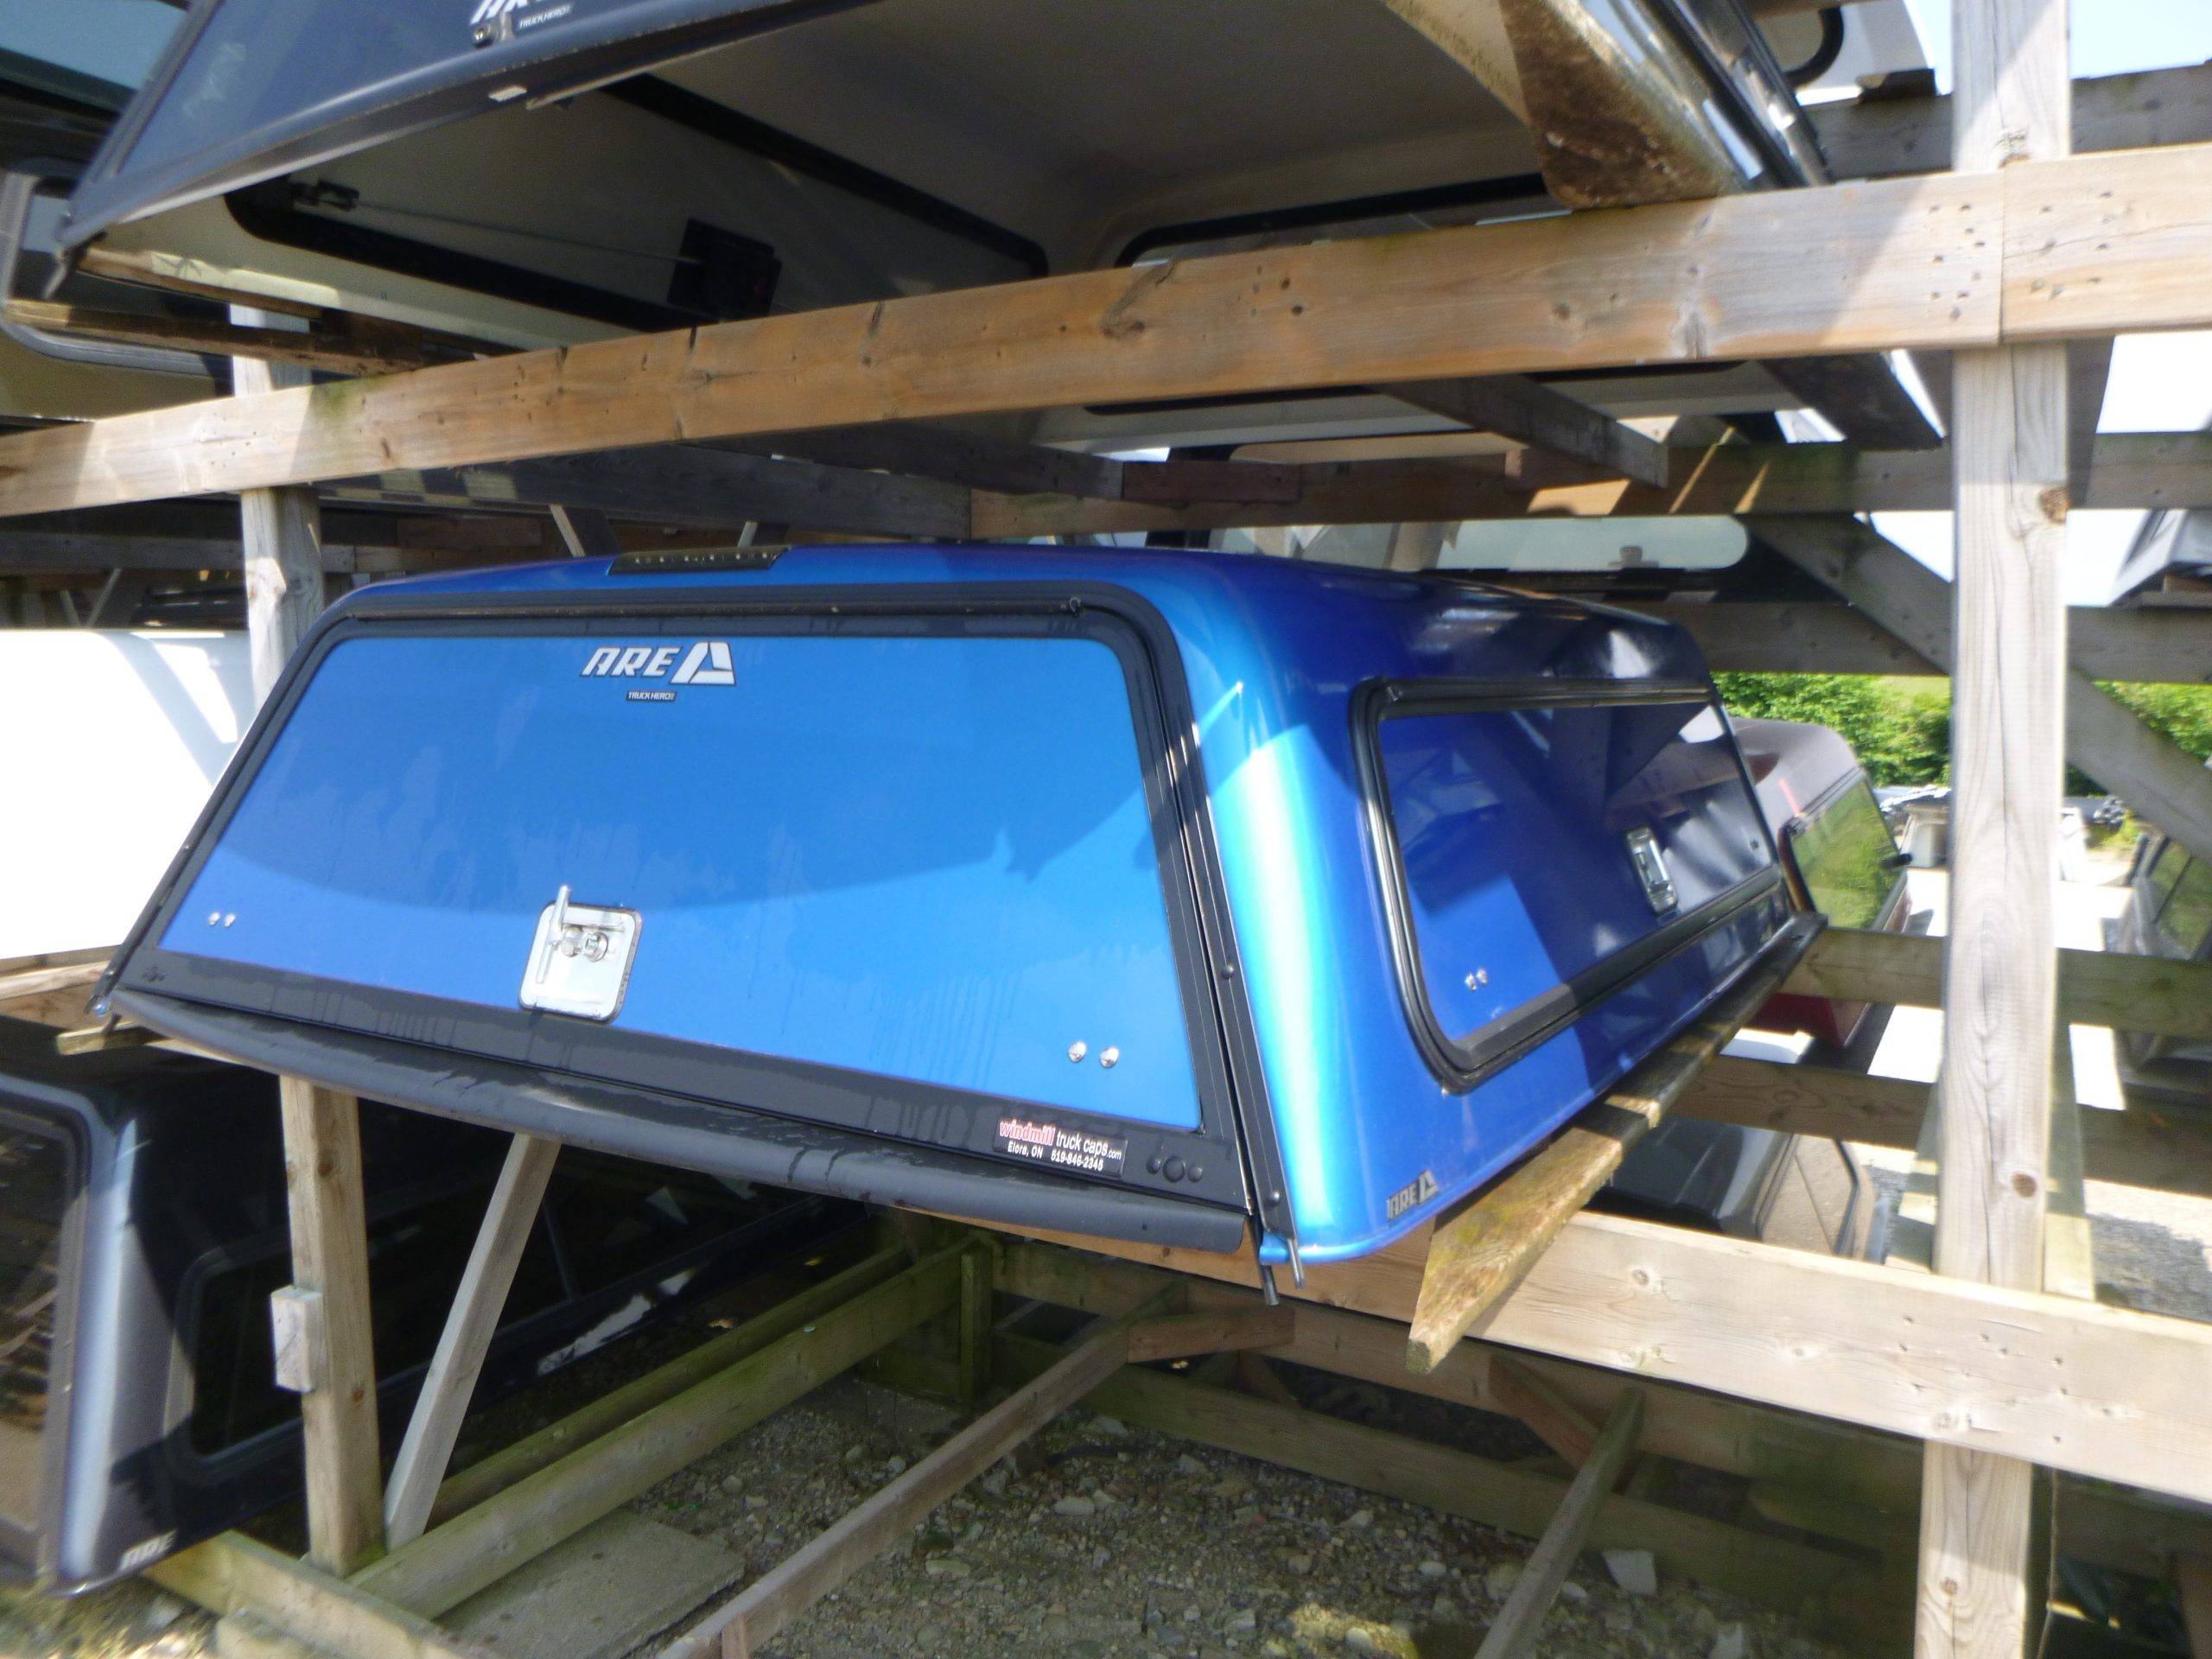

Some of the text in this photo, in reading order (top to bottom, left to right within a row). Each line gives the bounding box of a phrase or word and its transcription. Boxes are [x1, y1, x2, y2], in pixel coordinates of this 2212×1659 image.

[581, 647, 681, 677] ARE
[628, 691, 650, 701] TRUCK
[999, 1119, 1056, 1147] windmill
[1057, 1130, 1082, 1150] truck
[1007, 1141, 1028, 1157] Elora,
[1032, 1147, 1044, 1159] ON
